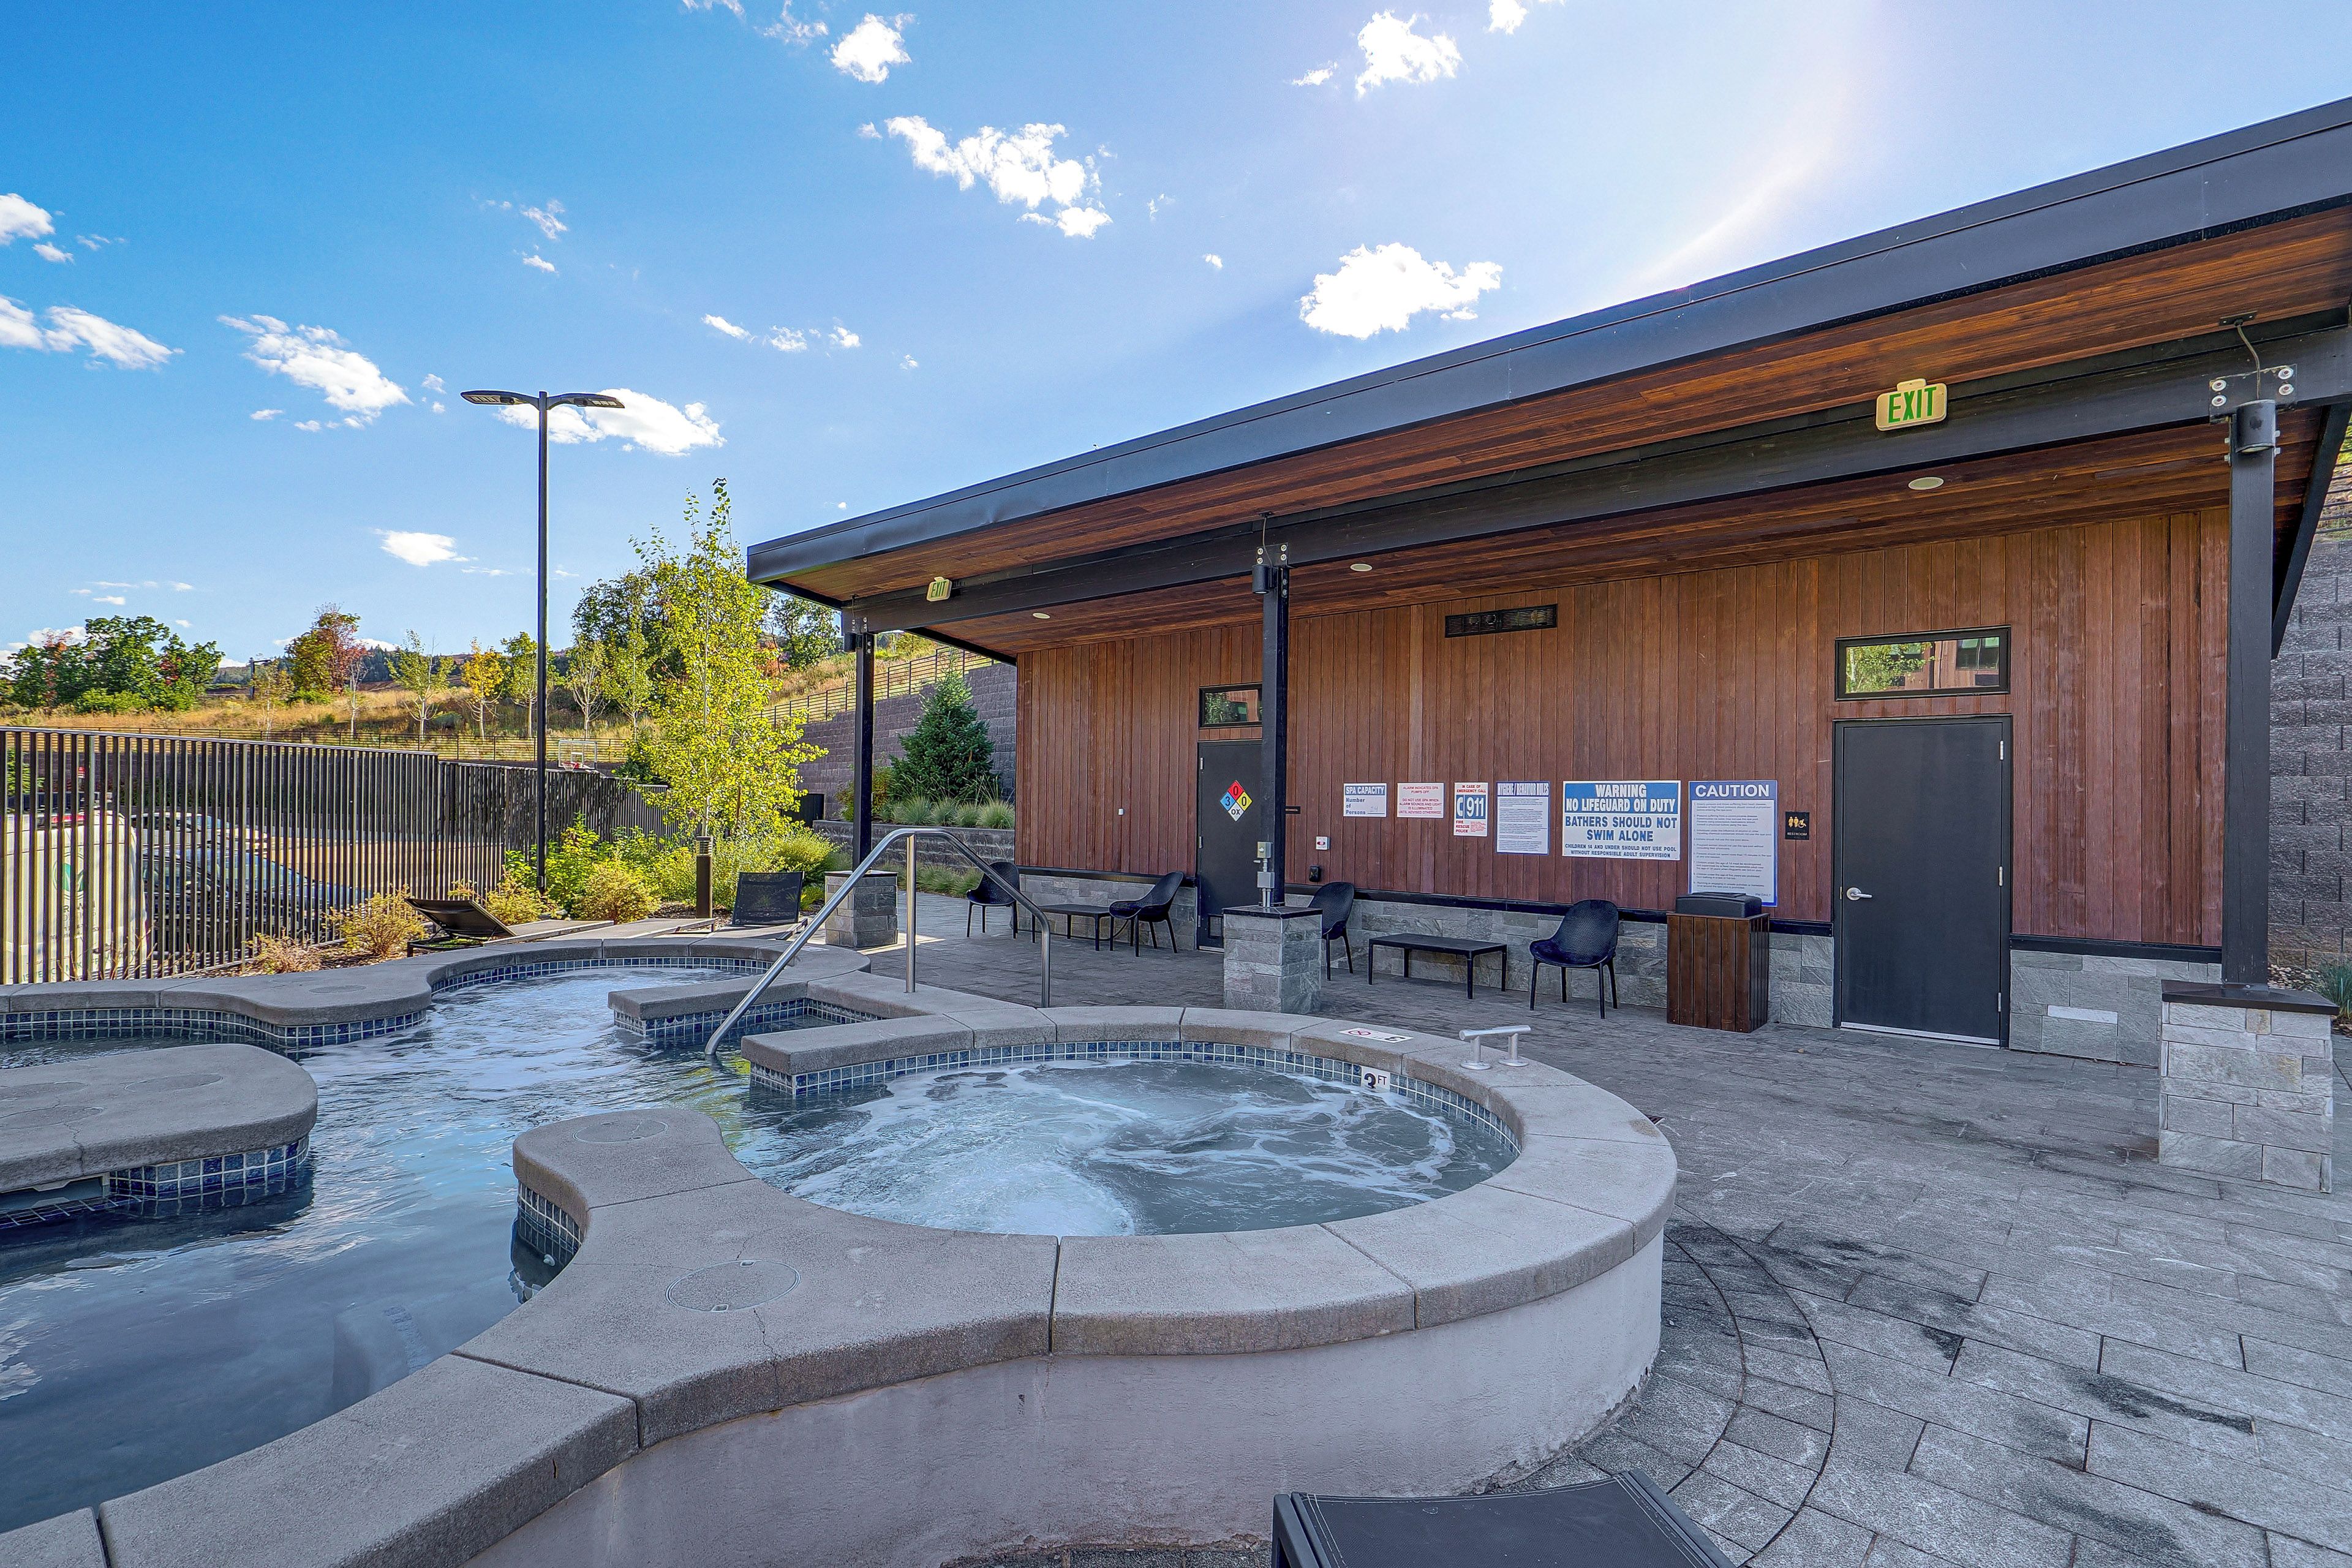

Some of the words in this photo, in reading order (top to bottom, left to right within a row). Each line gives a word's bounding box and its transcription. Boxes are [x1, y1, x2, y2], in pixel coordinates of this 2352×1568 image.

[1888, 386, 1937, 423] EXIT
[930, 581, 946, 598] EXIT
[1233, 785, 1238, 796] 0
[1346, 786, 1356, 794] SPA
[1357, 786, 1385, 794] CAPACITY
[1596, 784, 1647, 797] WARNING
[1695, 784, 1770, 797] CAUTION
[1225, 796, 1231, 806] 3
[1242, 796, 1247, 806] 0
[1466, 797, 1484, 817] 911
[1566, 798, 1578, 812] NO
[1581, 798, 1630, 812] LIFEGUARD
[1634, 798, 1646, 812] ON
[1650, 798, 1676, 812] DUTY
[1565, 816, 1608, 827] BATHERS
[1613, 816, 1652, 827] SHOULD
[1656, 817, 1677, 828] NOT
[1586, 829, 1614, 841] SWIM
[1618, 830, 1654, 842] ALONE
[1378, 1075, 1387, 1085] FT
